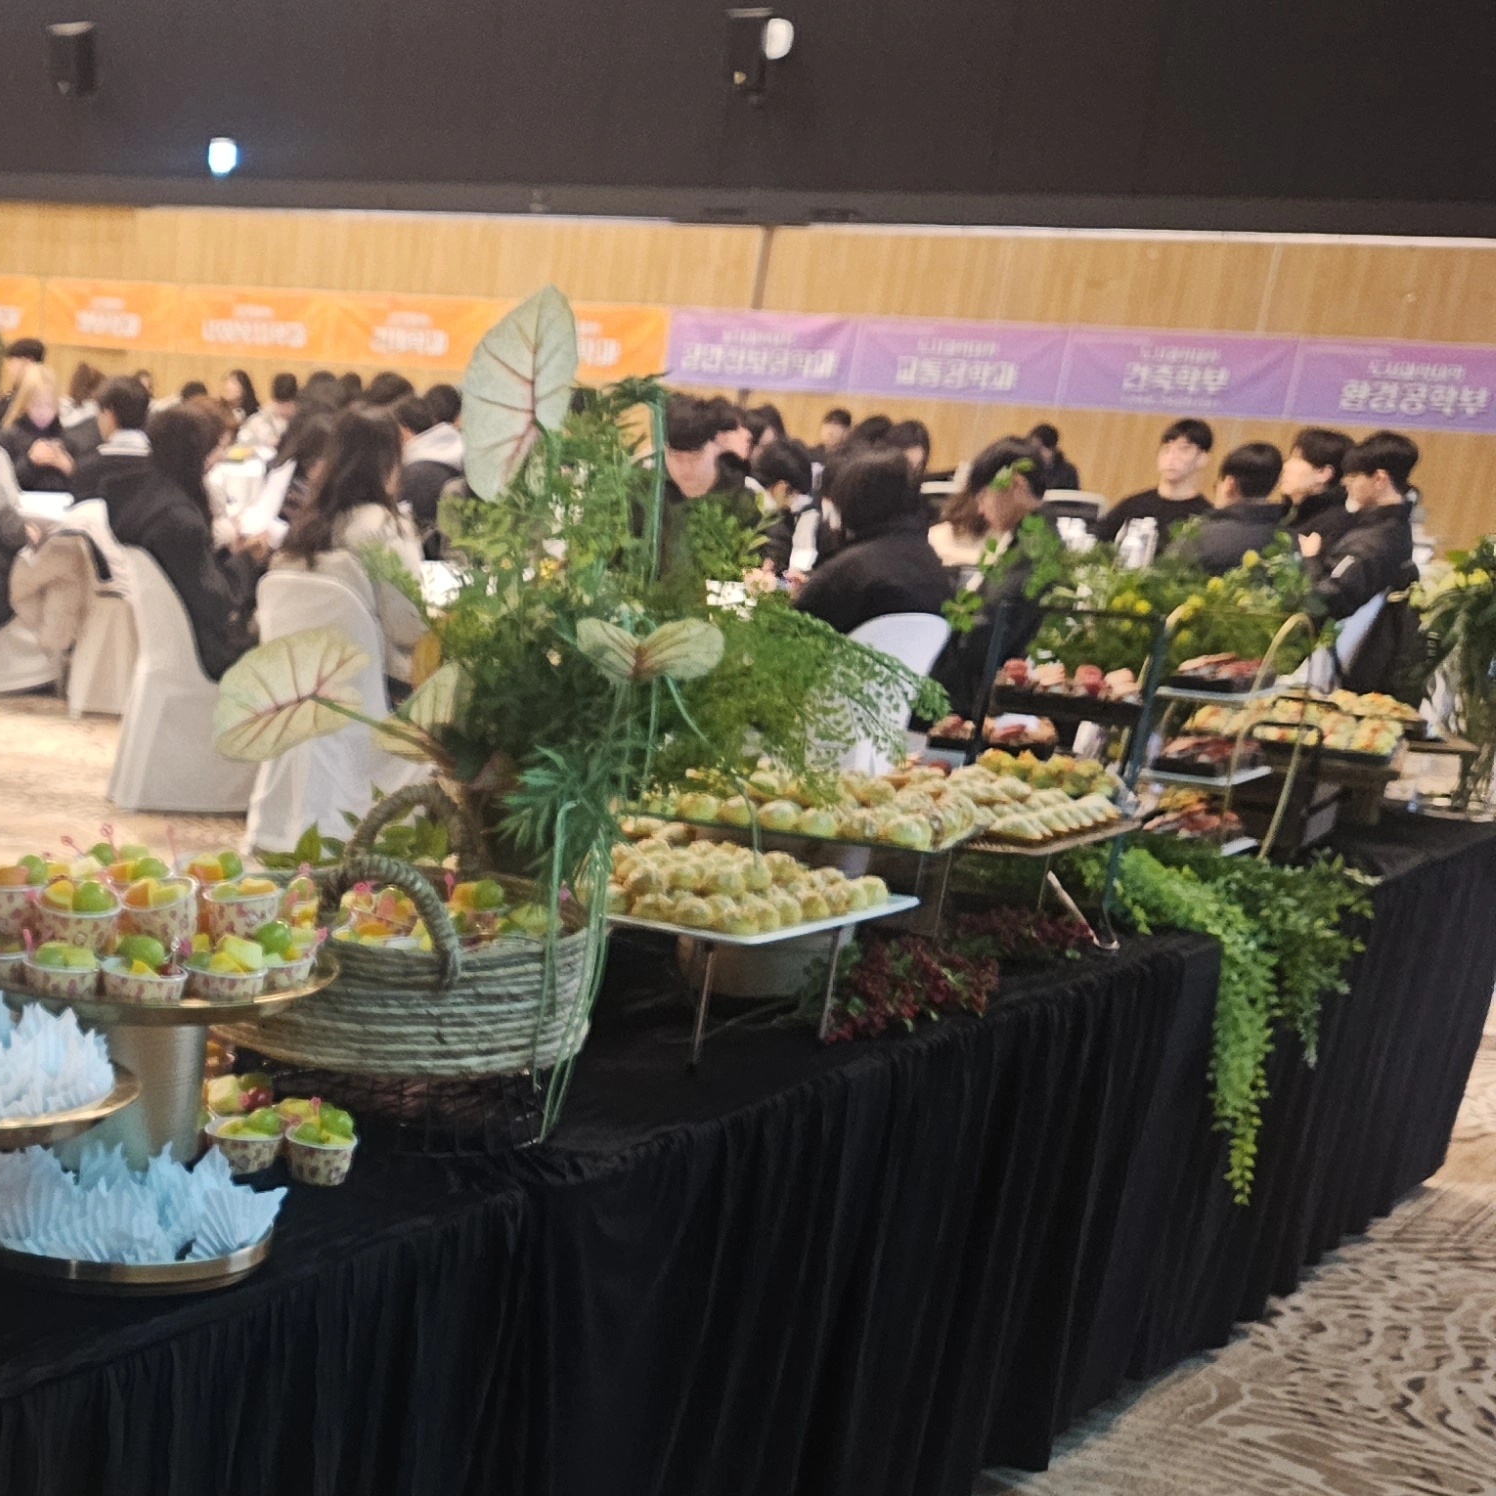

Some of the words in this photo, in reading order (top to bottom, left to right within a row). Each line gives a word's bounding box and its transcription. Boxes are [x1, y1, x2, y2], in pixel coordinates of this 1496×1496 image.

[895, 356, 1020, 391] 교통공학과
[1122, 361, 1231, 394] 건축학부
[1340, 378, 1488, 418] 환경공학부
